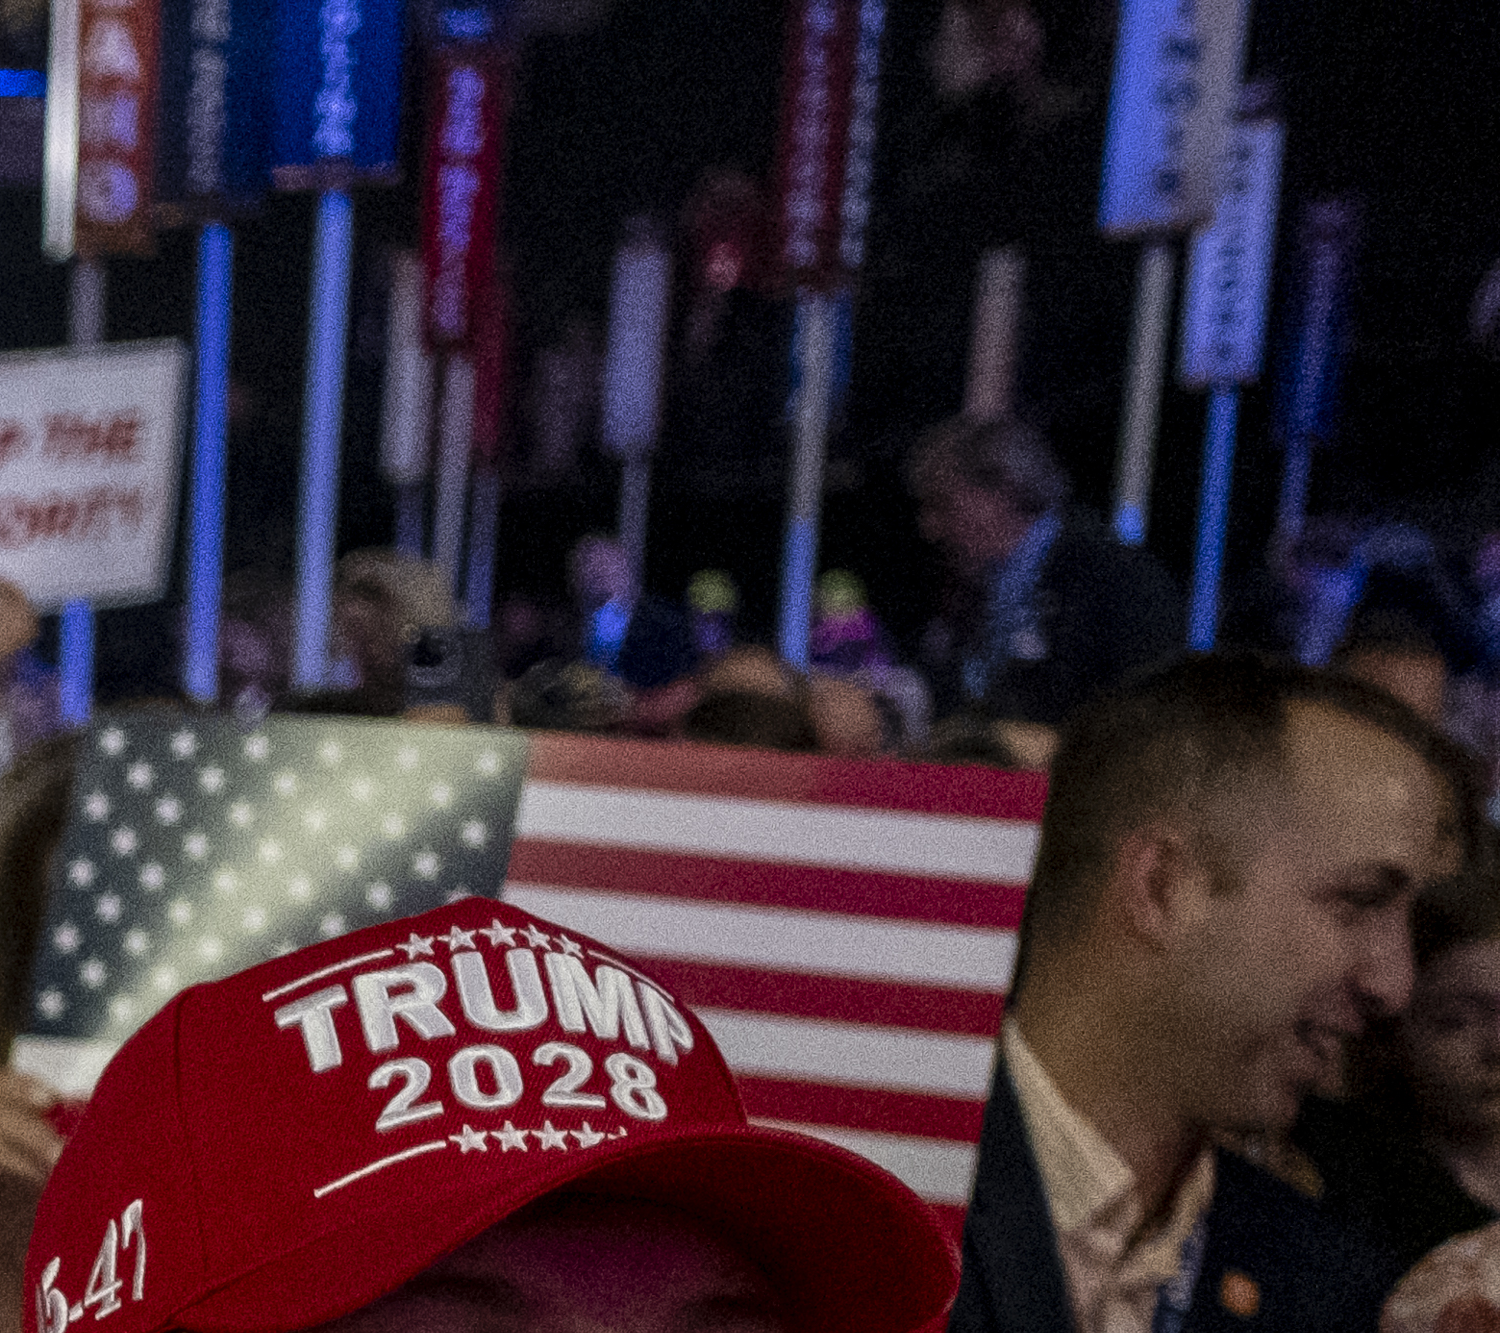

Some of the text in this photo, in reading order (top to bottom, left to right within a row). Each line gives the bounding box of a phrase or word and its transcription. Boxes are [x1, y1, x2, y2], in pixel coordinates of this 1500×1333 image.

[43, 407, 142, 462] THE
[275, 946, 693, 1074] TRUMP
[368, 1042, 668, 1133] 2028
